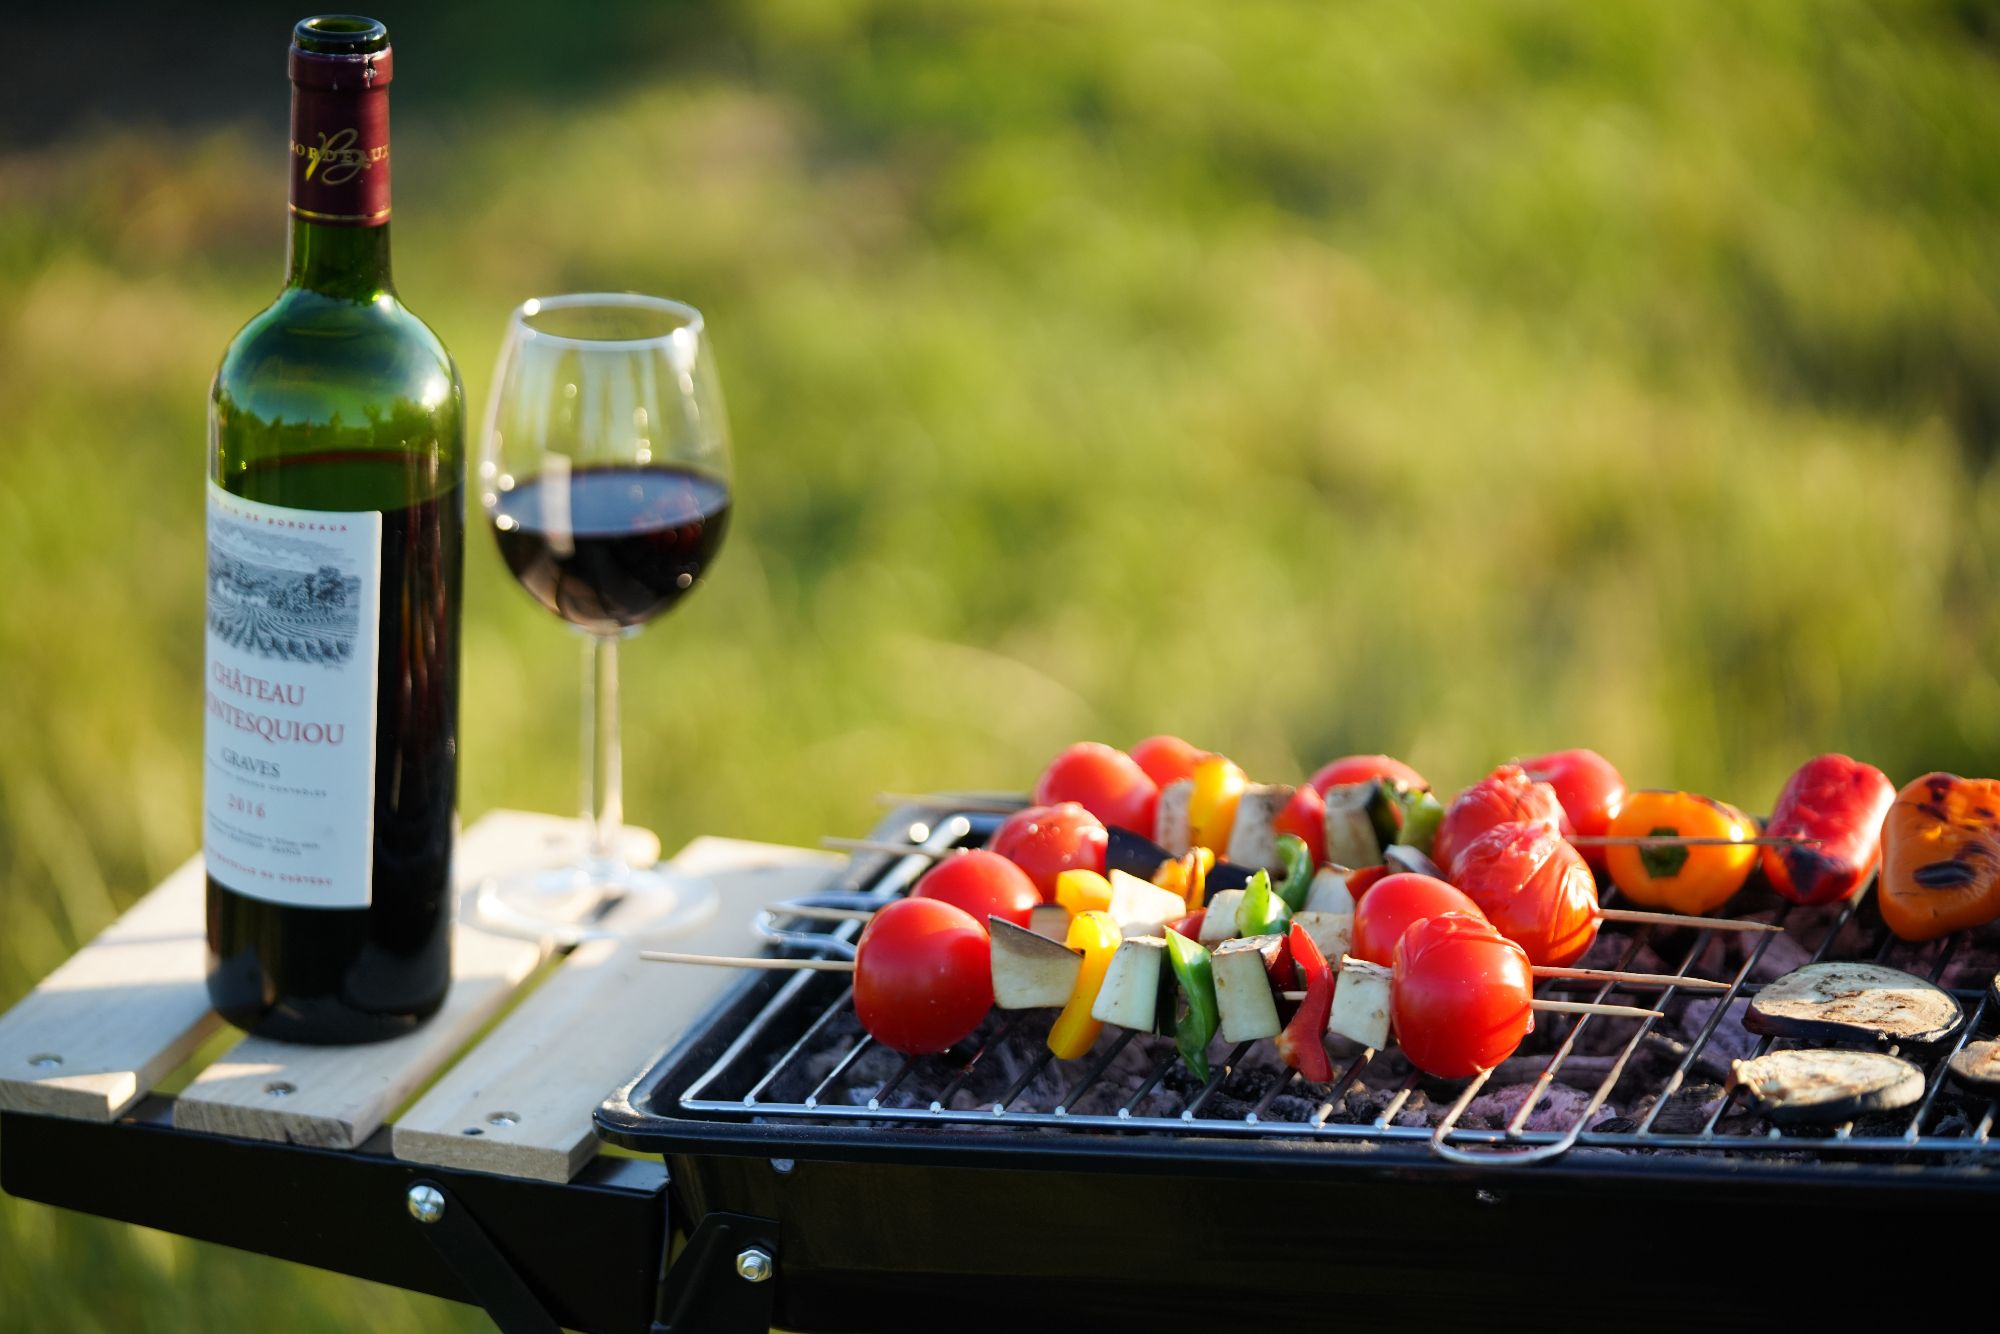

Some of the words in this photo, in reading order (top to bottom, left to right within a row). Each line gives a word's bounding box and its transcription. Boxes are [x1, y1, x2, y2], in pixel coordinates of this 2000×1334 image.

[268, 517, 349, 532] BORDEAUX
[213, 660, 306, 706] CHÂTEAU
[221, 747, 281, 778] GRAVES
[226, 792, 267, 819] 2016
